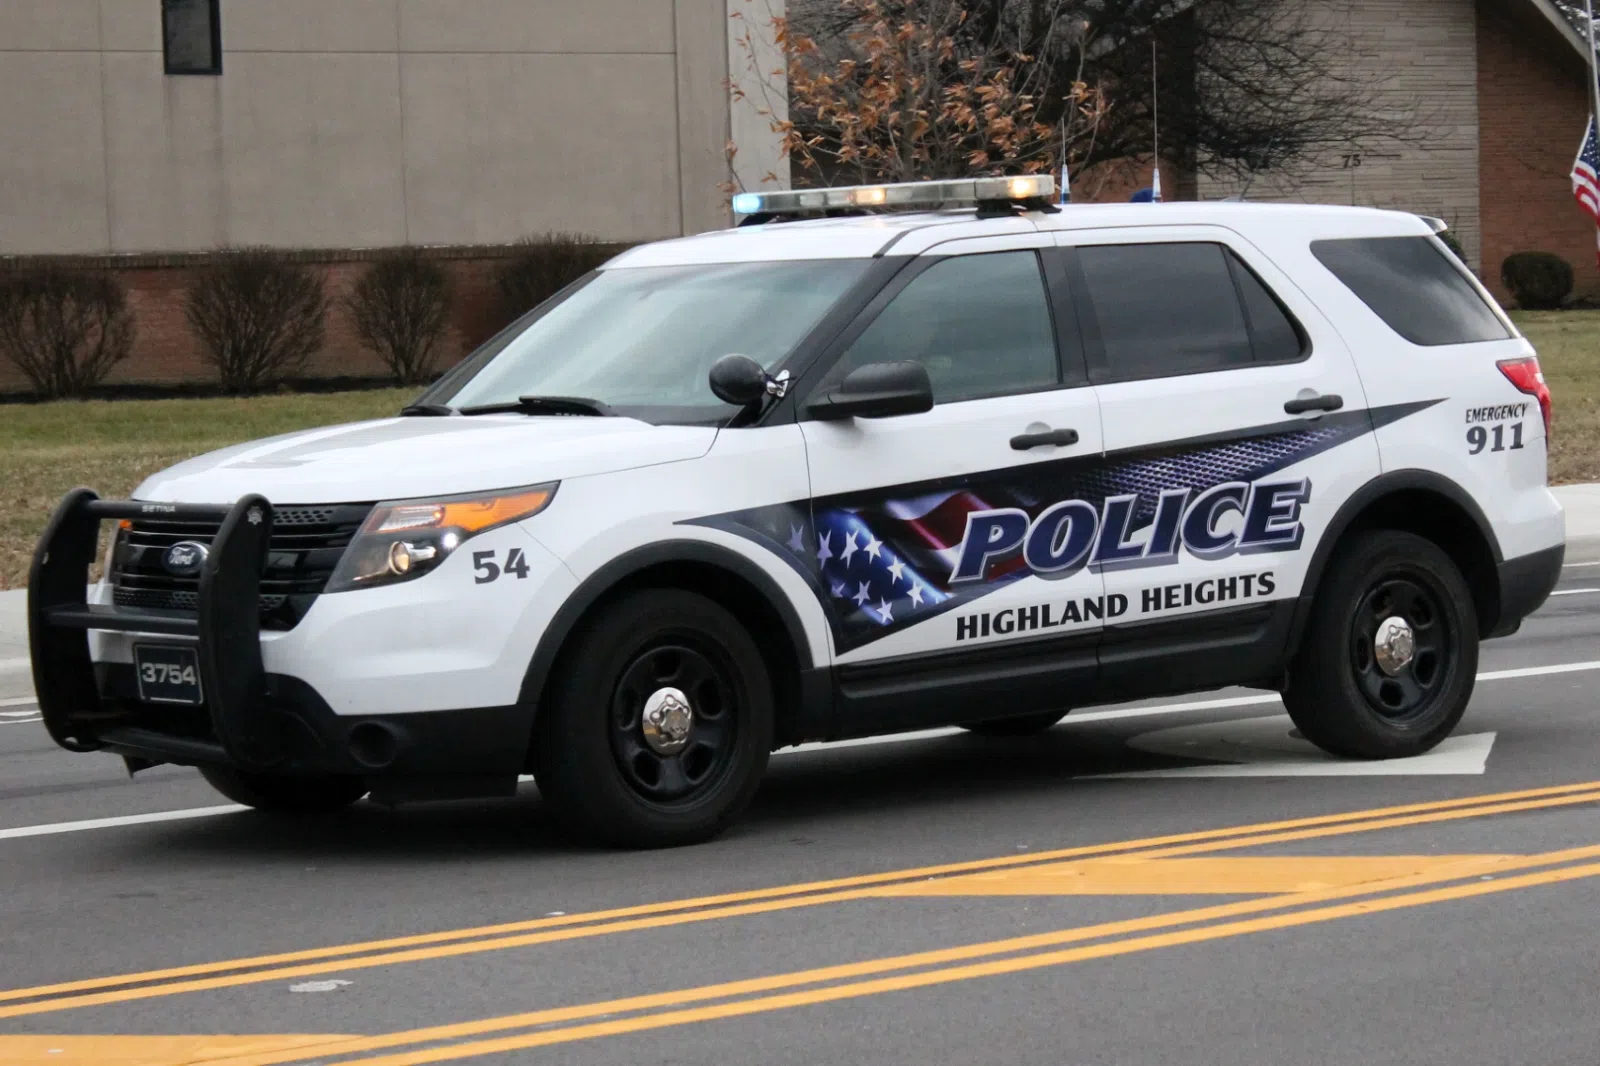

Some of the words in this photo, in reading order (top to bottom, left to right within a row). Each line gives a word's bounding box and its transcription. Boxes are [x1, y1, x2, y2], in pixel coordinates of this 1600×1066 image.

[1466, 403, 1528, 423] EMERGENCY
[1466, 421, 1524, 455] 911
[949, 477, 1312, 584] POLICE
[168, 547, 196, 565] Ford
[473, 548, 530, 584] 54
[956, 593, 1129, 640] HIGHLAND
[1141, 571, 1276, 613] HEIGHTS
[141, 662, 196, 685] 3754
